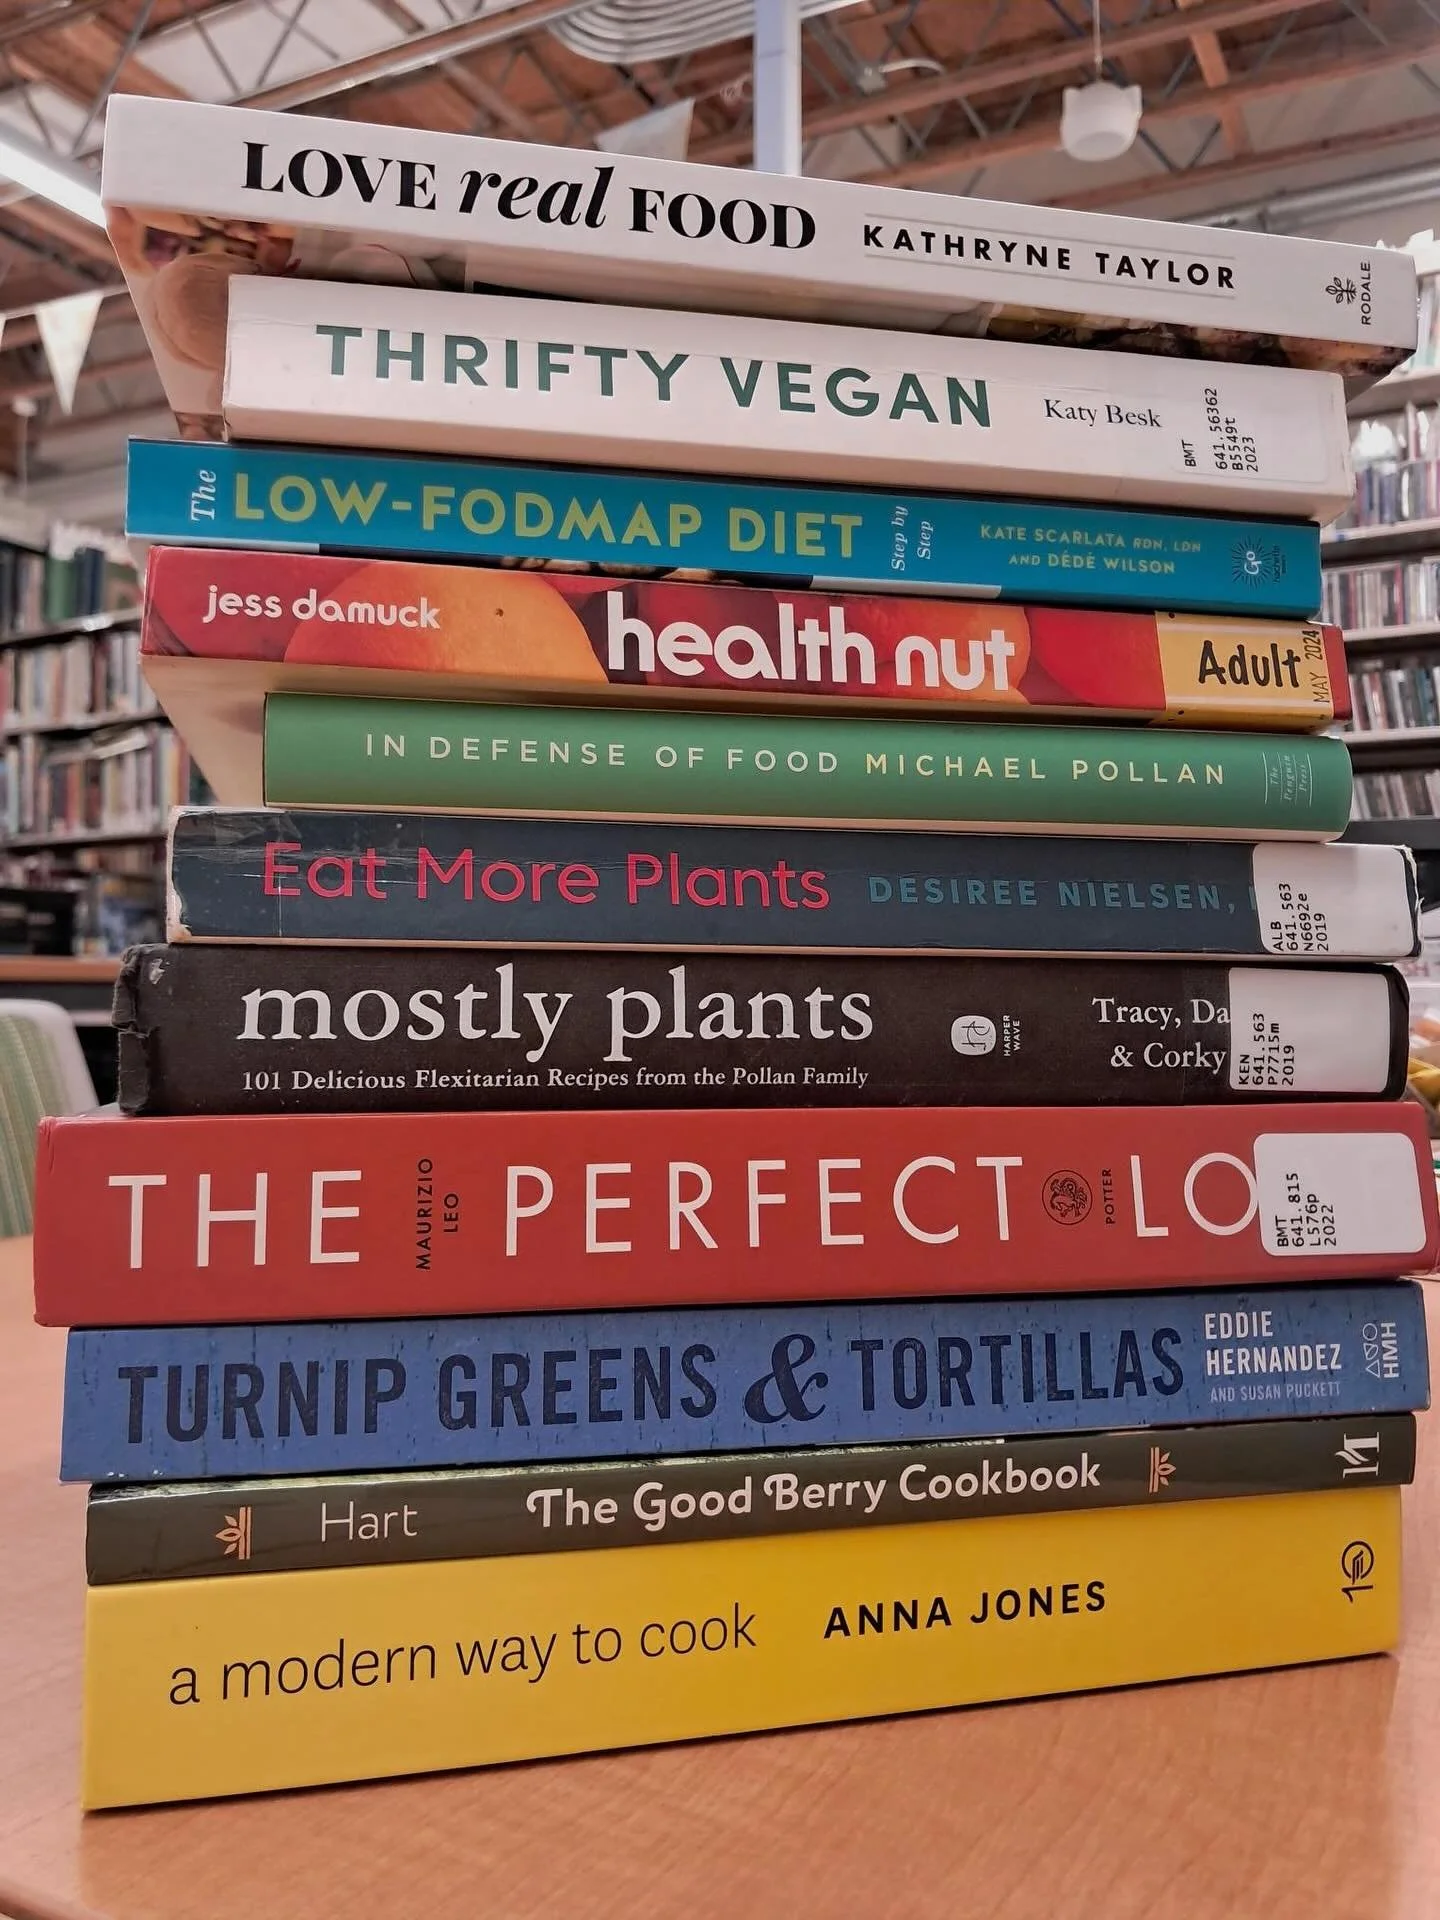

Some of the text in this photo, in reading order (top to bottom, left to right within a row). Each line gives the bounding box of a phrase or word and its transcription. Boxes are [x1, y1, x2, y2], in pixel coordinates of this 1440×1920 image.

[243, 141, 816, 251] LOVE real FOOD
[863, 224, 1235, 290] KATHRYNE TAYLOR
[1360, 261, 1371, 325] RODALE
[315, 324, 991, 429] THRIFTY VEGAN
[1044, 398, 1097, 430] Katy
[1204, 387, 1228, 470] 641.56362
[1181, 439, 1197, 467] BMT
[1225, 417, 1244, 471] B5549t
[1242, 436, 1259, 472] 2023
[190, 468, 218, 521] The
[234, 473, 862, 558] LOW-FODMAP DIET
[890, 505, 909, 571] Step by
[917, 520, 935, 560] Step
[980, 525, 1027, 541] KATE
[1034, 529, 1126, 548] SCARLATA
[1009, 554, 1041, 566] AND
[1103, 558, 1176, 574] WILSON
[203, 585, 441, 630] jess damuck
[607, 590, 1015, 691] health nut
[1199, 640, 1301, 688] Adult
[1301, 630, 1330, 703] MAY 2024
[366, 732, 1225, 785] IN DEFENSE OF FOOD MICHAEL POLLAN
[264, 841, 830, 910] Eat More Plants
[868, 876, 1038, 907] DESIREE
[1270, 921, 1284, 951] ALB
[1279, 883, 1298, 951] 641.563
[1297, 893, 1314, 952] N6692e
[1313, 913, 1329, 952] 2019
[236, 961, 874, 1064] mostly plants
[1002, 1014, 1012, 1057] HARPER
[1012, 1019, 1022, 1052] WAVE
[1092, 996, 1182, 1029] Tracy,
[1110, 1041, 1227, 1075] & Corky
[1239, 1054, 1250, 1085] KEN
[1252, 1013, 1265, 1085] 641.563
[1267, 1022, 1280, 1086] P7715m
[1282, 1045, 1295, 1086] 2019
[242, 1066, 869, 1092] 101 Delicious Flexitarian Recipes from the Pollan Family
[108, 1168, 363, 1269] THE
[416, 1158, 433, 1270] MAURIZIO
[443, 1193, 459, 1233] LEO
[505, 1155, 1024, 1257] PERFECT
[1102, 1168, 1116, 1225] POTTER
[1286, 1172, 1304, 1247] 641.815
[1305, 1193, 1320, 1247] L576p
[1275, 1215, 1289, 1247] BMT
[1321, 1204, 1337, 1247] 2022
[1204, 1310, 1274, 1340] EDDIE
[1381, 1322, 1400, 1378] HMH
[118, 1327, 1184, 1444] TURNIP GREENS & TORTILLAS
[1206, 1343, 1342, 1376] HERNANDEZ
[1210, 1381, 1341, 1404] AND SUSAN PUCKETT
[321, 1453, 1102, 1543] Hart The Good Berry Cookbook
[823, 1580, 1107, 1640] ANNA JONES
[169, 1602, 757, 1706] a modern way to cook
